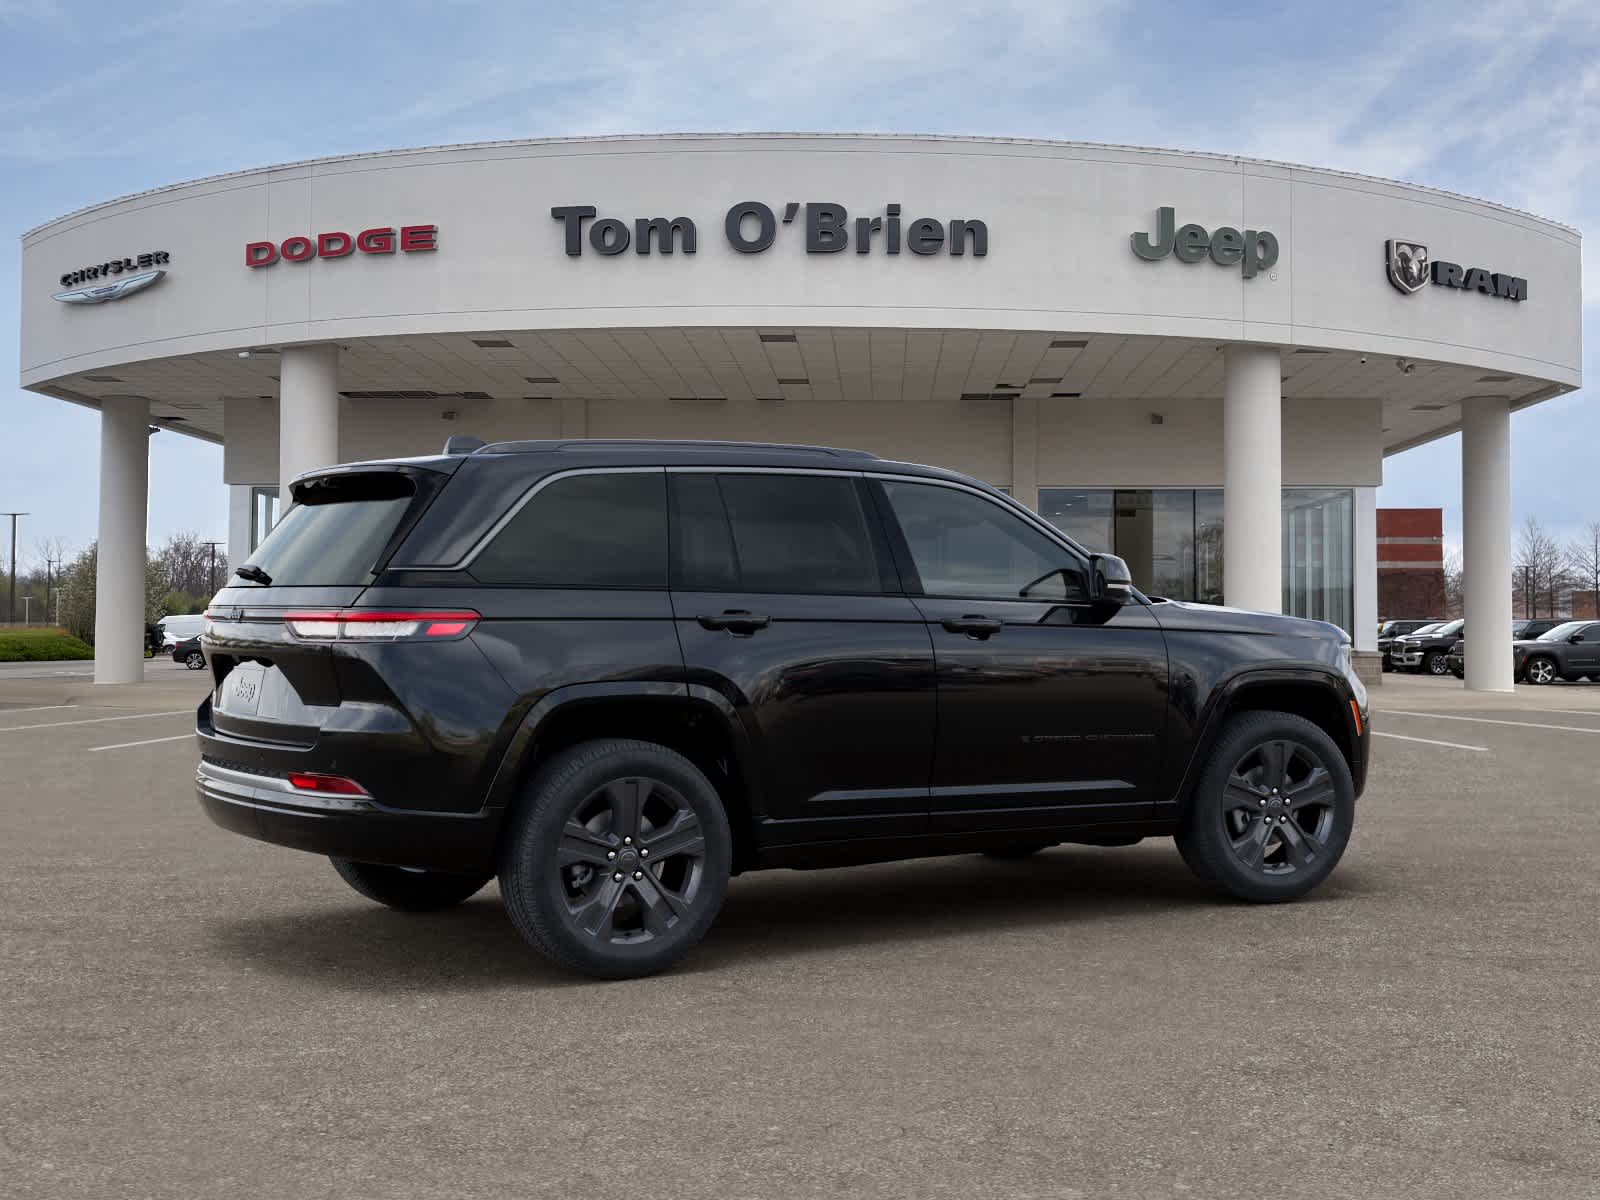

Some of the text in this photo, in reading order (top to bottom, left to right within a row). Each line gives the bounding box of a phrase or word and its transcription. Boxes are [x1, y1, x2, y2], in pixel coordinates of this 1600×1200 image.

[245, 224, 438, 268] DODGE
[550, 201, 989, 256] Tom O'Brien
[1130, 206, 1280, 278] Jeep
[60, 249, 170, 287] CHRYSLER
[1430, 260, 1528, 302] RAM
